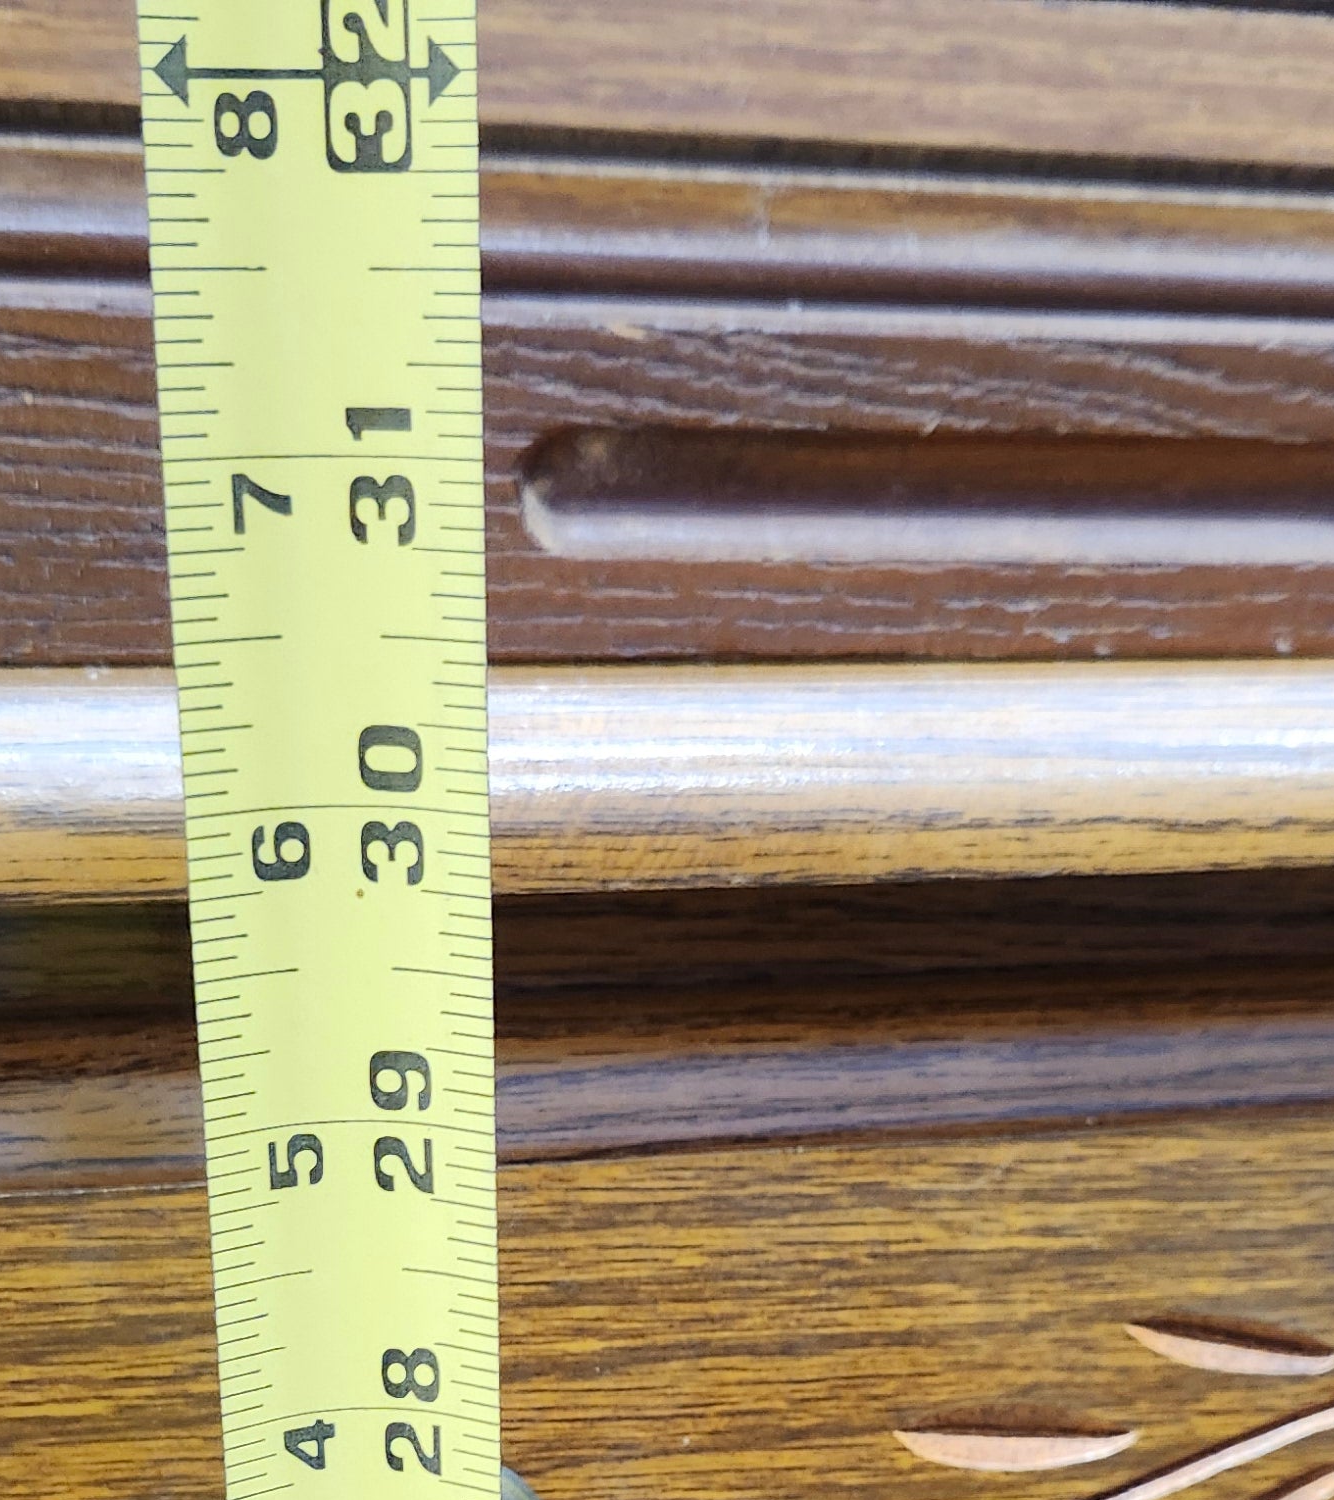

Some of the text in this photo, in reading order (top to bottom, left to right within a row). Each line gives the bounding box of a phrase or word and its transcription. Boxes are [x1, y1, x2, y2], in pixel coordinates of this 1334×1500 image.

[214, 90, 278, 160] 8
[328, 0, 408, 164] 32
[231, 473, 292, 534] 7
[345, 407, 415, 546] 31
[252, 821, 311, 881] 6
[358, 725, 424, 885] 30
[268, 1134, 323, 1190] 5
[370, 1051, 434, 1194] 29
[284, 1419, 335, 1470] 4
[381, 1348, 441, 1475] 28
